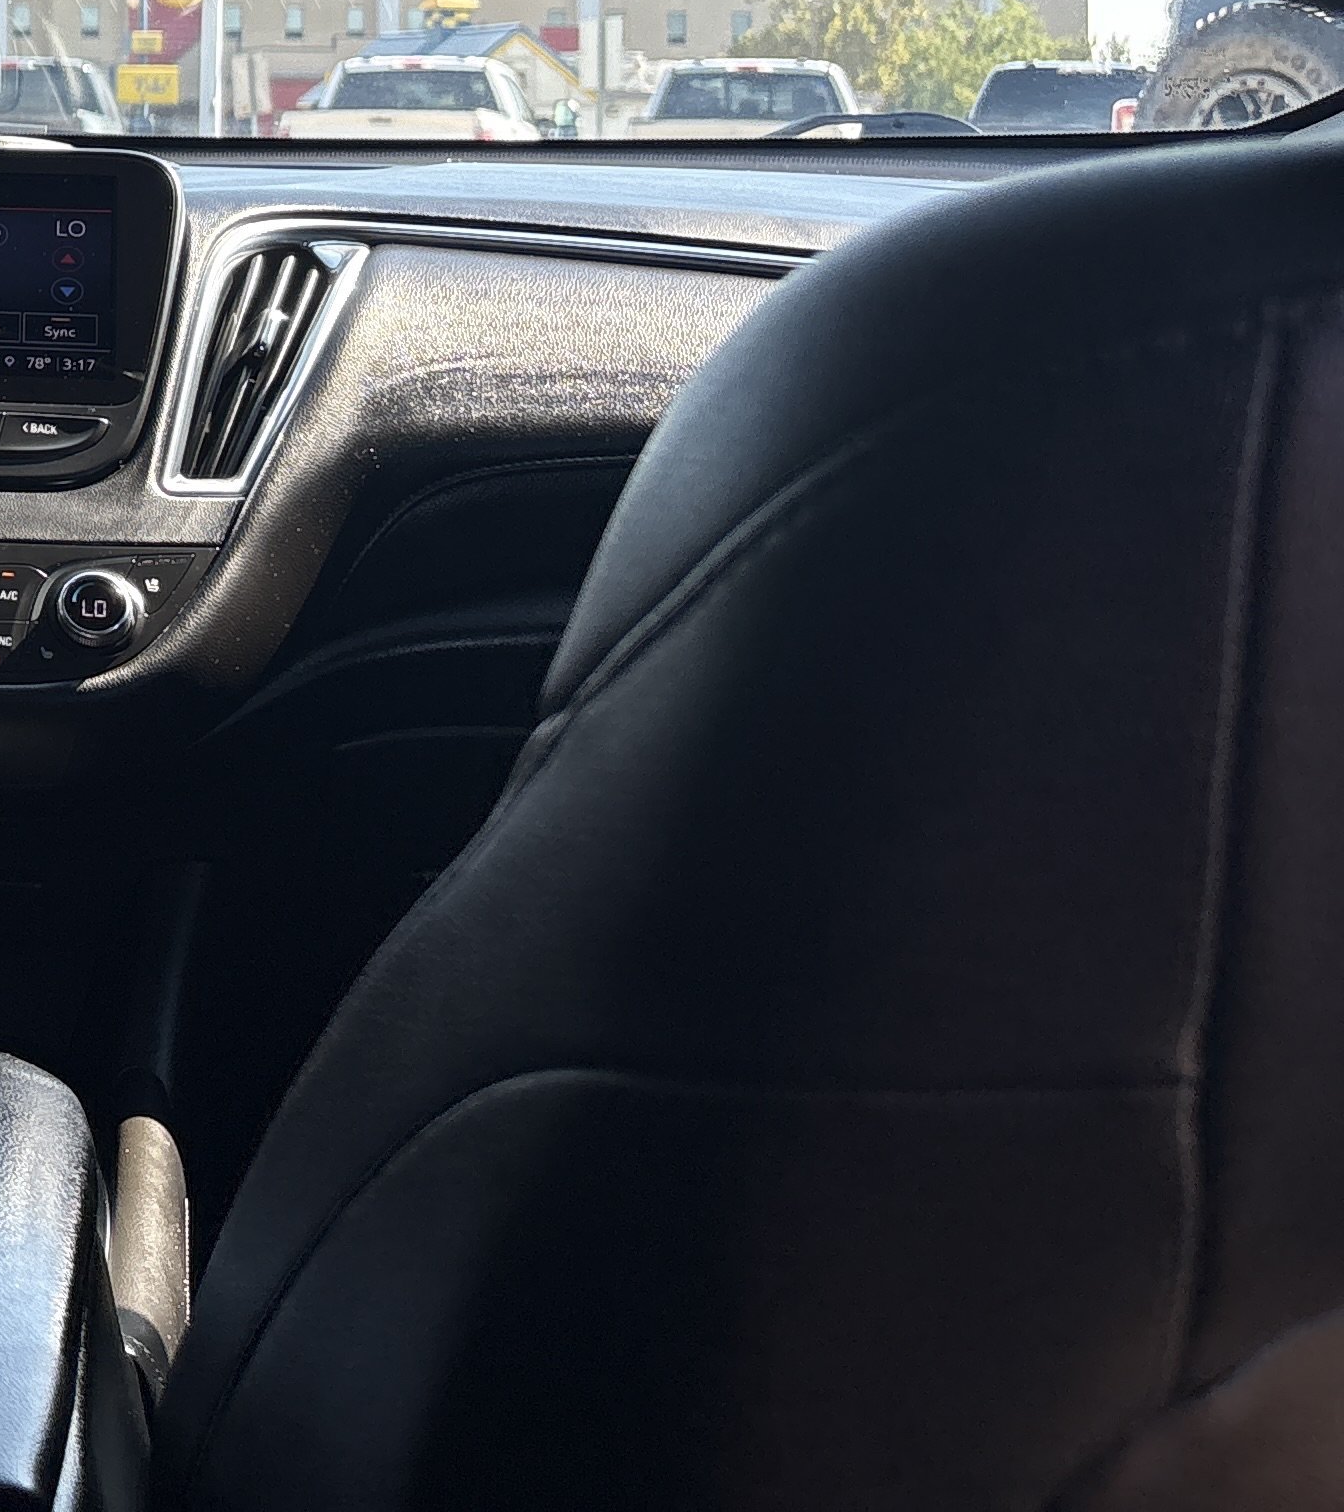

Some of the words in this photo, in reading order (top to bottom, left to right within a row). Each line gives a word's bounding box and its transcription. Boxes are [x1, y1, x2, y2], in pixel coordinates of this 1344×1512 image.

[56, 220, 86, 238] LO
[43, 324, 76, 339] Sync
[26, 356, 52, 370] 78°
[62, 358, 96, 372] 3:17
[30, 423, 57, 436] BACK
[0, 588, 19, 603] A/C
[82, 599, 108, 618] LO
